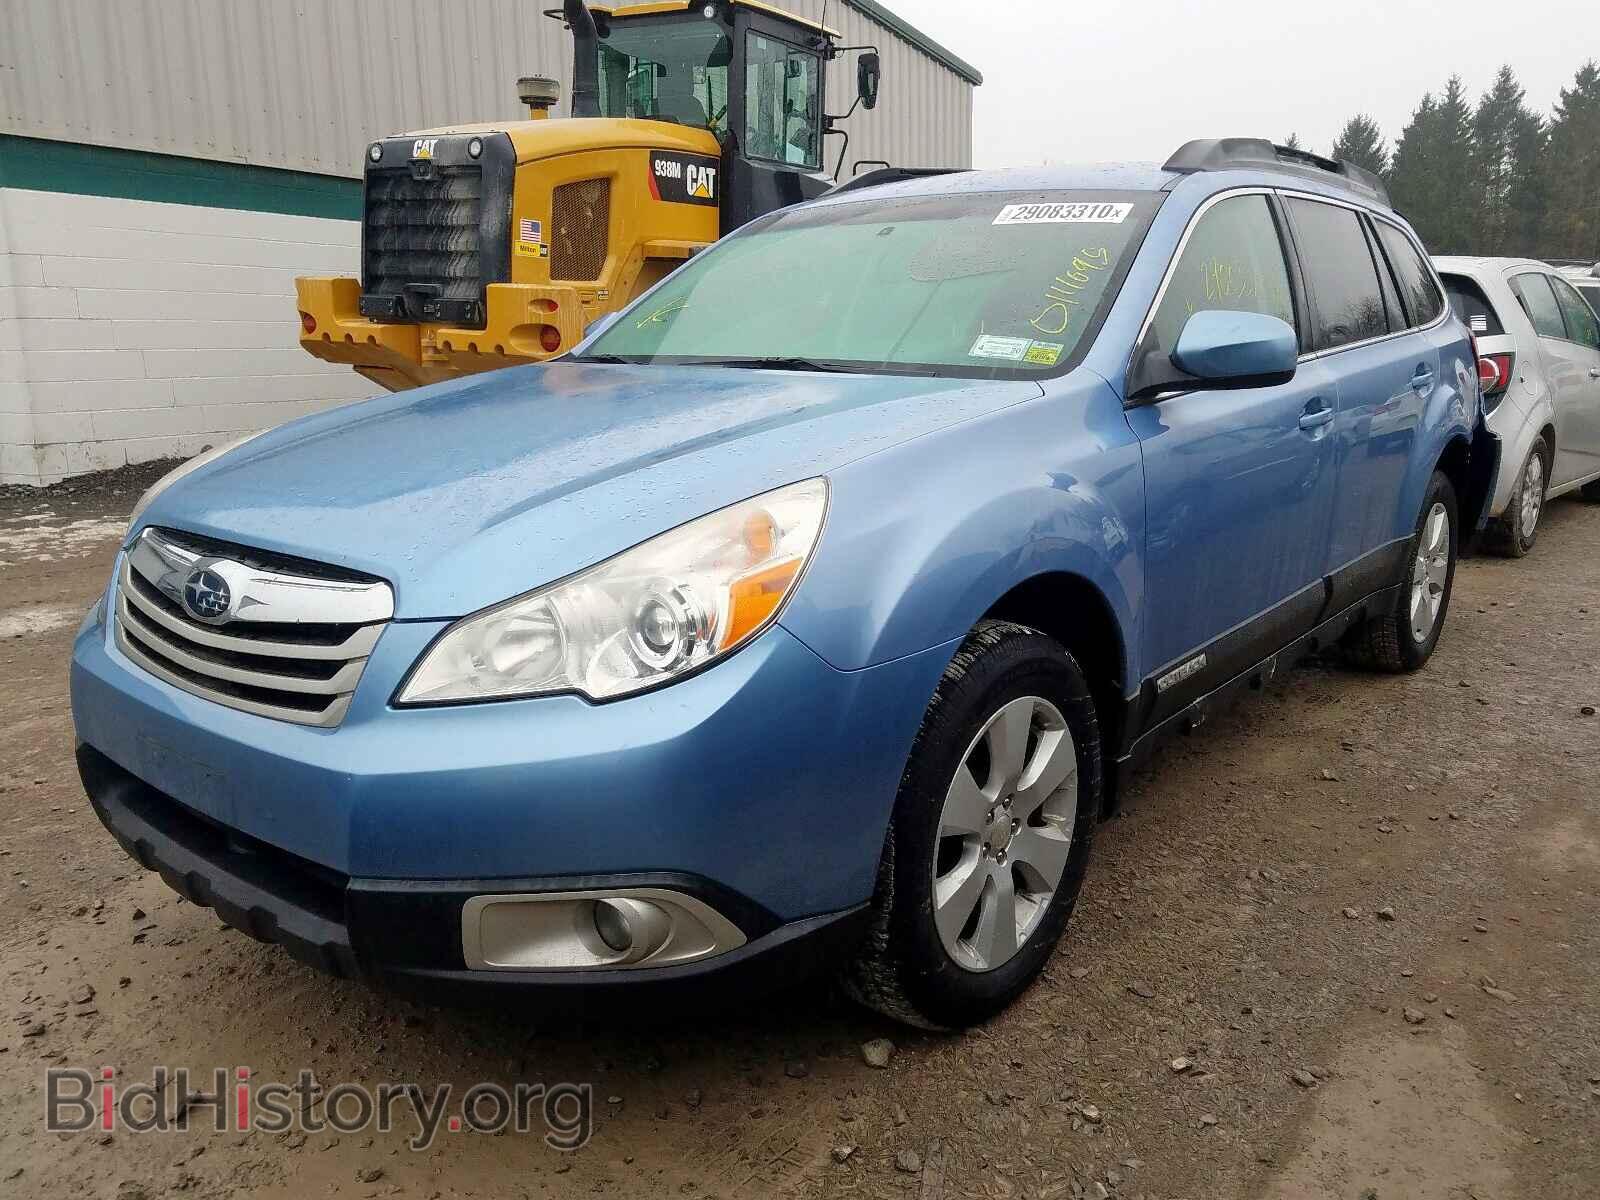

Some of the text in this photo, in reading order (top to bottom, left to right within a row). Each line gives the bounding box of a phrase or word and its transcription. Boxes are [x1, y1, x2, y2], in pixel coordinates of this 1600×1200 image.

[413, 139, 438, 158] CAT
[655, 160, 681, 178] 938M
[687, 164, 716, 199] CAT
